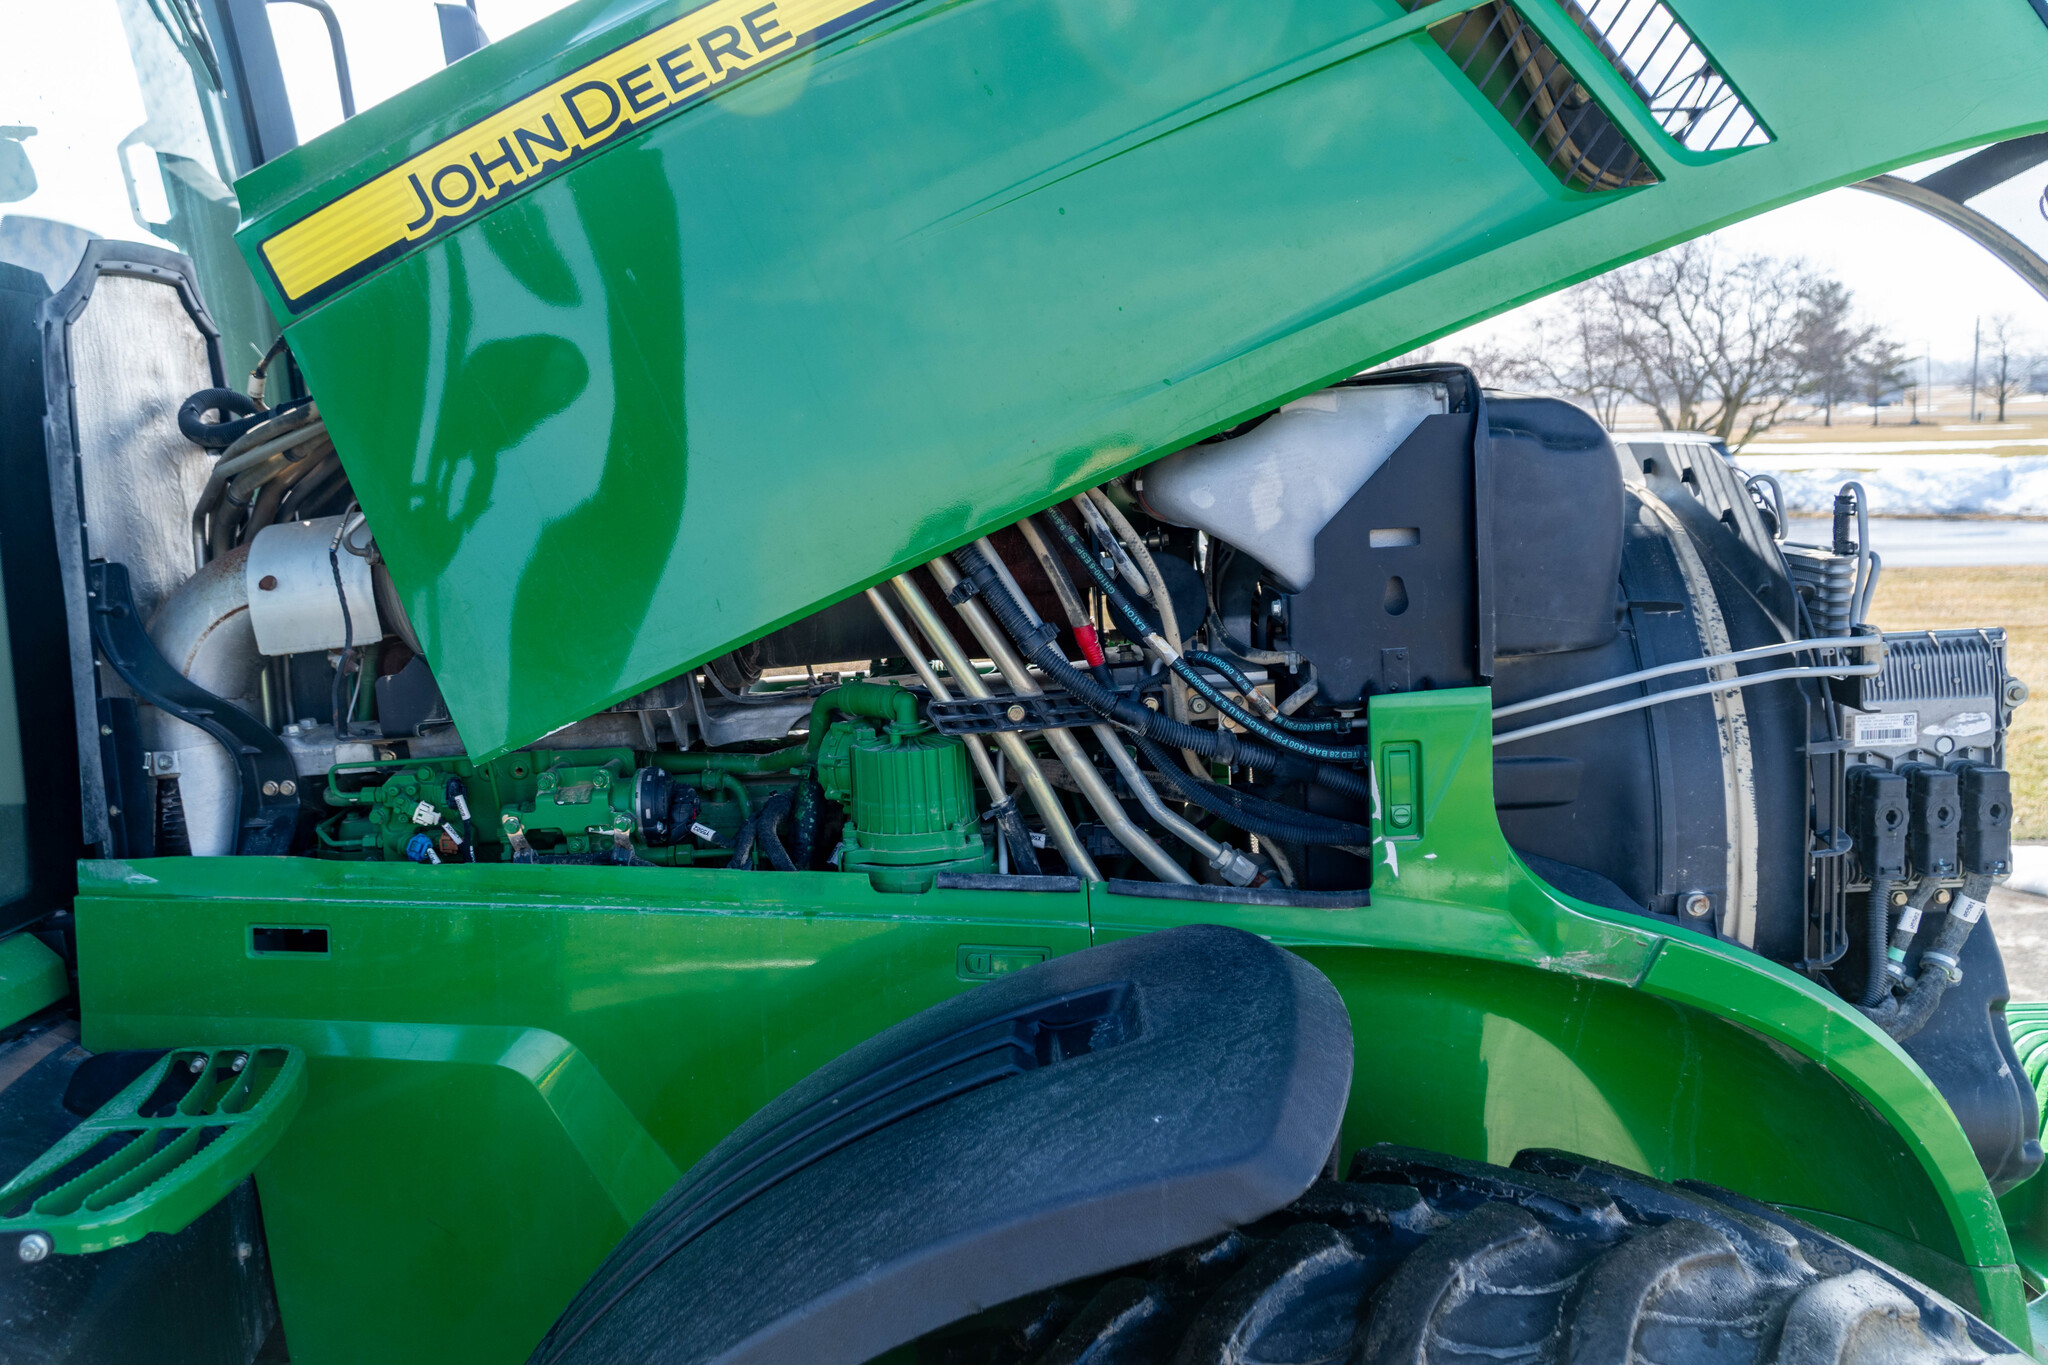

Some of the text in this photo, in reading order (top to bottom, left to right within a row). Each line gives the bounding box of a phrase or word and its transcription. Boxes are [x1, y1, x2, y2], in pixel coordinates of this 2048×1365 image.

[406, 1, 794, 232] JOHN DEERE
[1089, 563, 1116, 594] GH100-6
[1122, 604, 1147, 632] EATON
[1183, 667, 1213, 696] 0000060
[1214, 693, 1236, 714] U.S.A.
[1234, 711, 1245, 719] IN
[1244, 716, 1270, 736] MADE
[1314, 722, 1332, 731] BAR
[1270, 731, 1289, 745] PSI)
[1288, 740, 1308, 753] (400
[1308, 748, 1328, 758] BAR
[1329, 750, 1340, 759] 28
